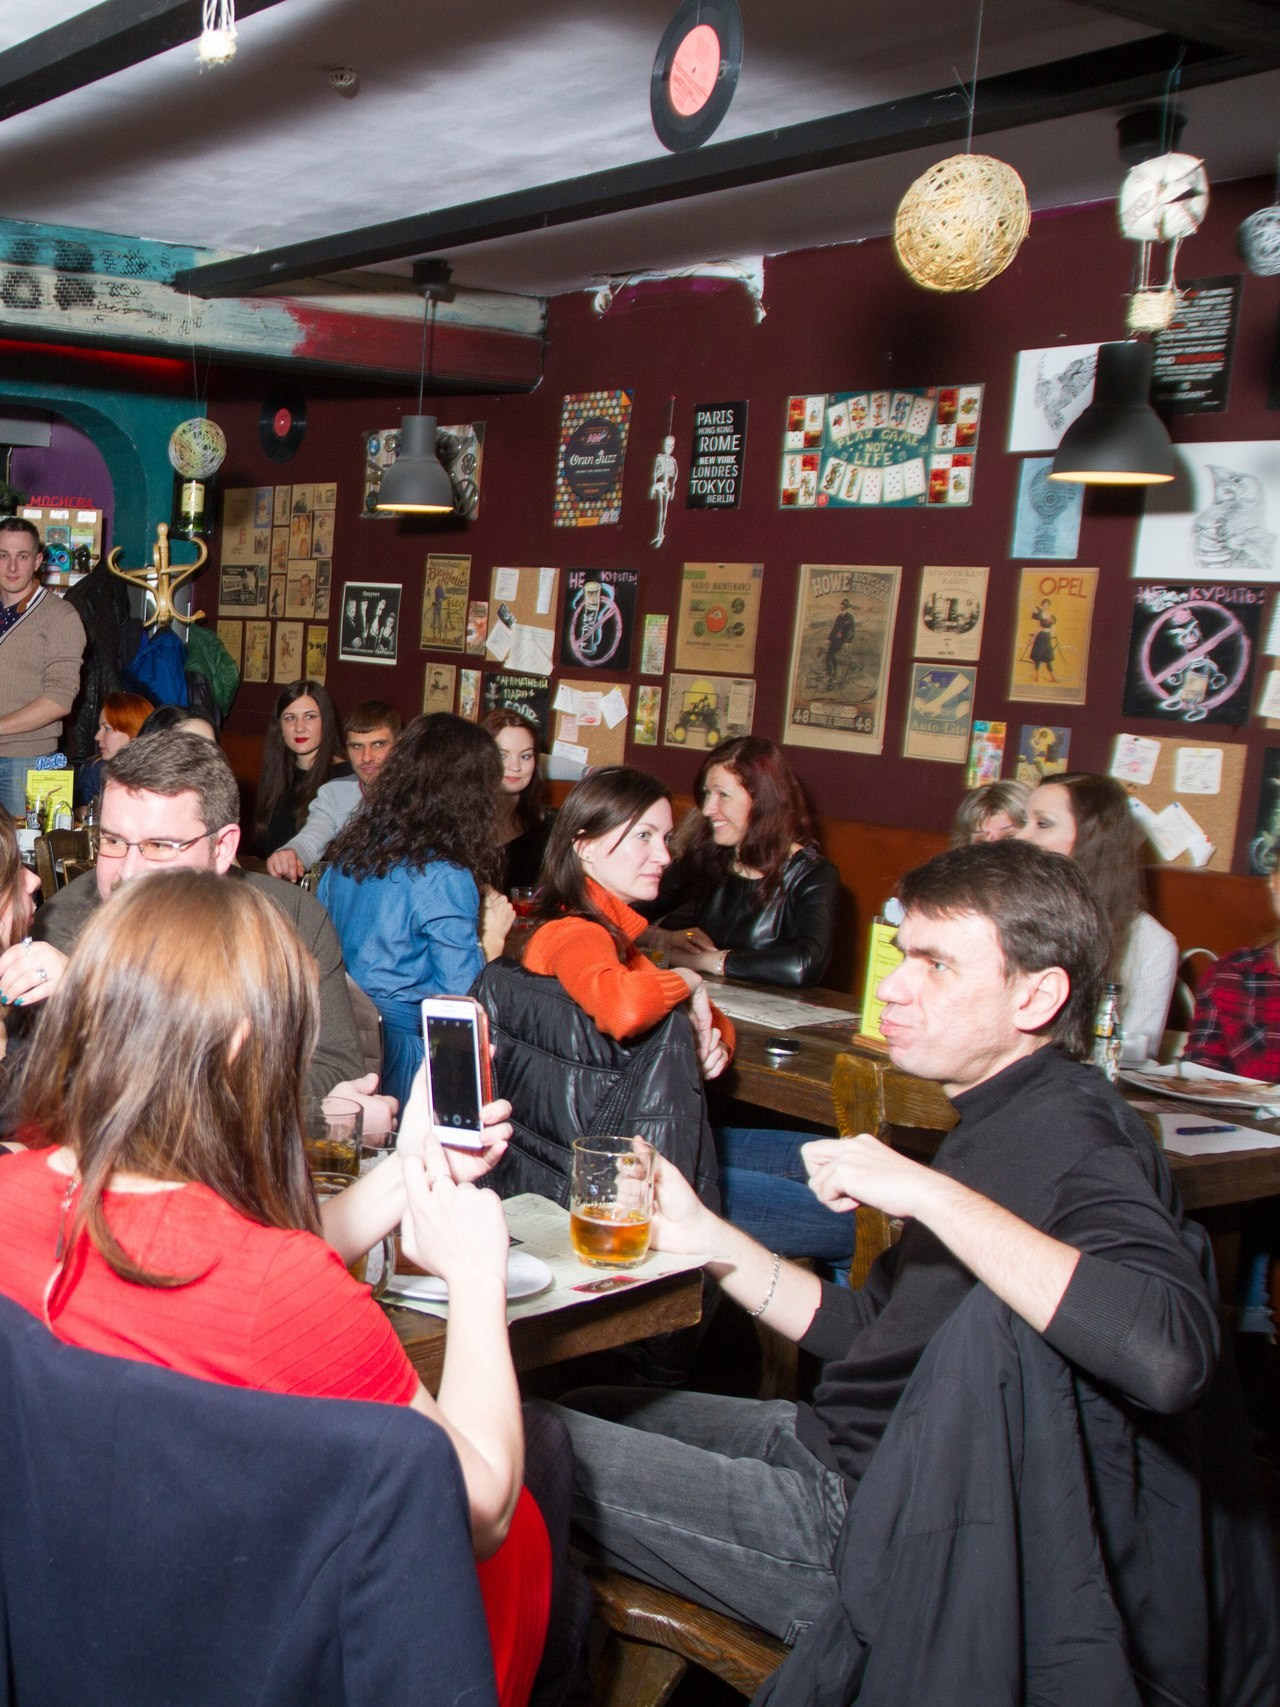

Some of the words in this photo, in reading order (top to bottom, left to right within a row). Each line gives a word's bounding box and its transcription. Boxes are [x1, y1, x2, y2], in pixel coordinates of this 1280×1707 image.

[697, 409, 734, 425] PARIS
[698, 426, 716, 435] HONG
[717, 425, 734, 434] KONG
[881, 429, 920, 446] GAME
[700, 435, 741, 452] ROME
[864, 442, 886, 453] NOT
[699, 456, 716, 465] NEW
[717, 455, 736, 464] YORK
[854, 452, 893, 465] LIFE
[692, 465, 739, 478] LONDRES
[690, 479, 735, 494] TOKYO
[706, 494, 735, 503] BERLIN
[570, 571, 586, 588] НЕ
[812, 572, 852, 598] HOWE
[1039, 576, 1087, 599] OPEL
[794, 709, 810, 724] 48
[855, 716, 873, 732] 48
[910, 720, 968, 736] Auto-Lite
